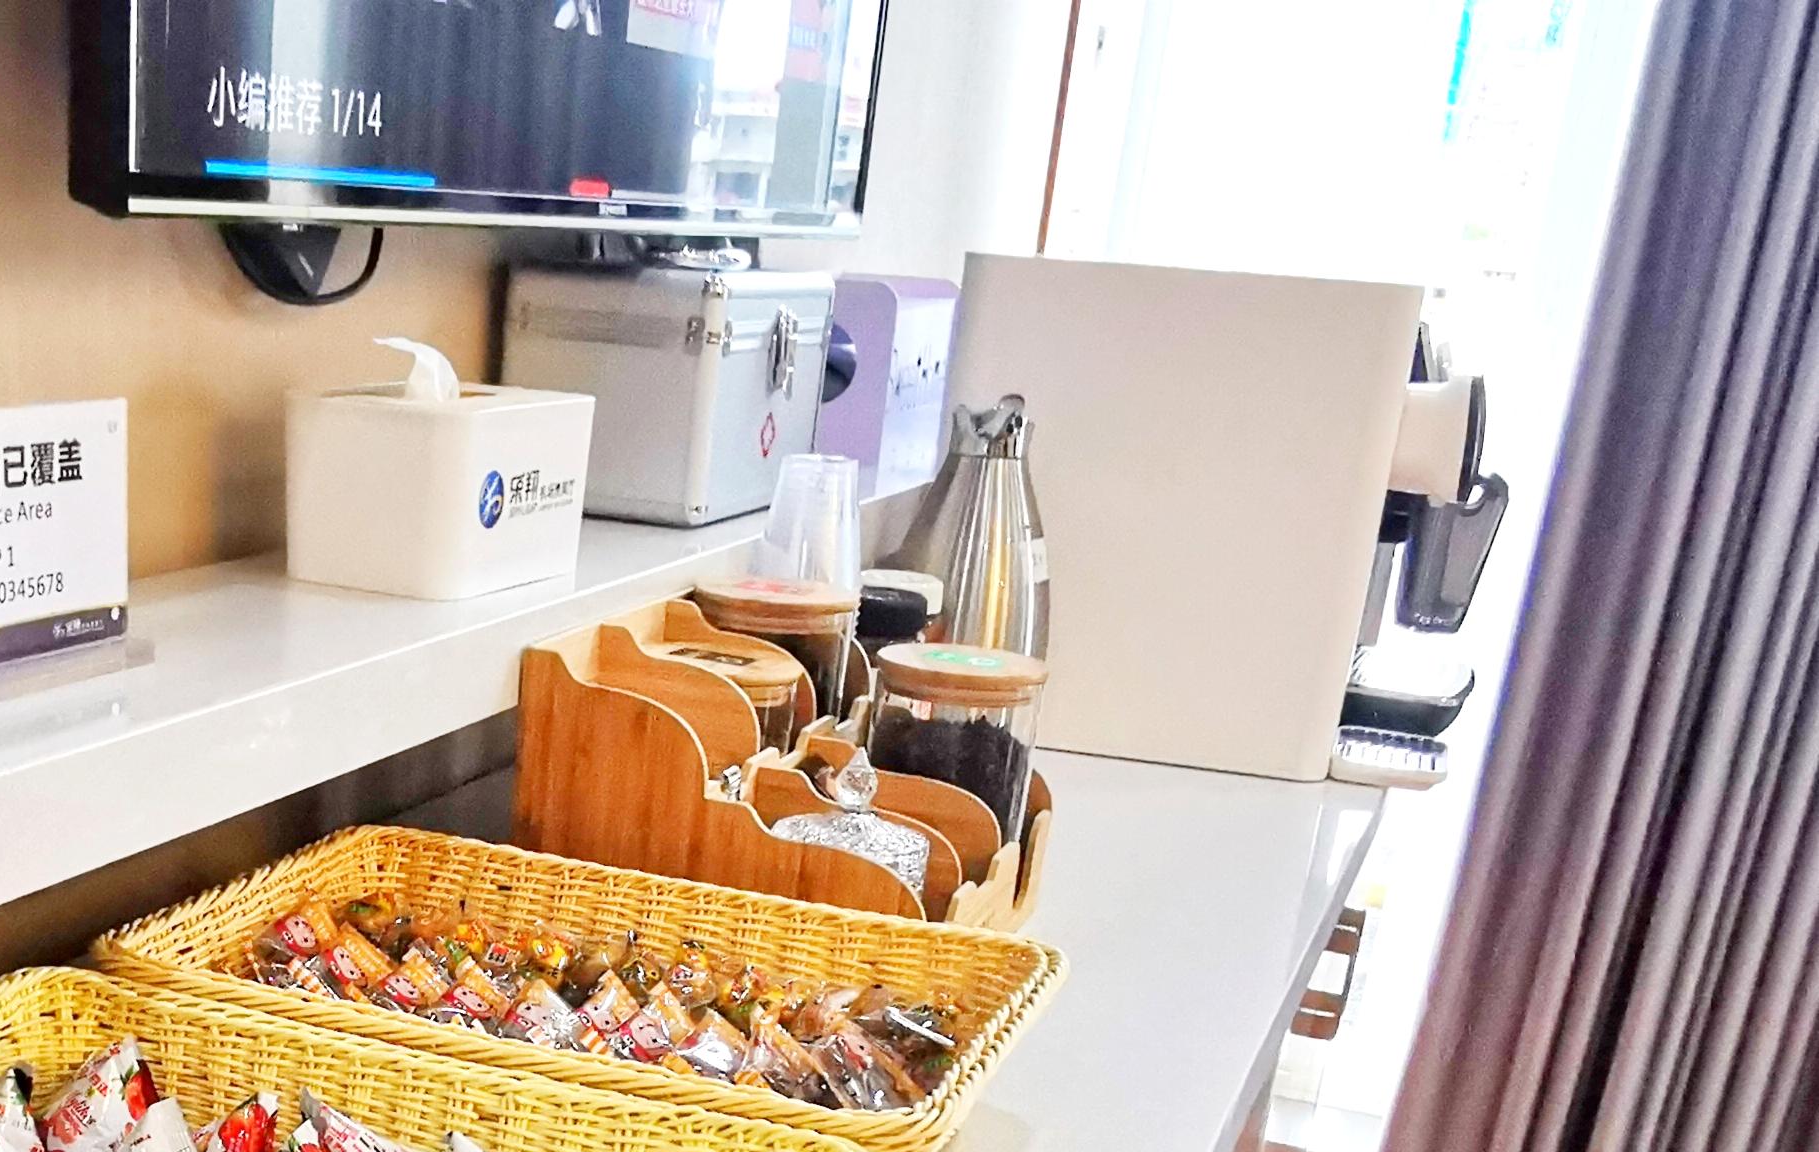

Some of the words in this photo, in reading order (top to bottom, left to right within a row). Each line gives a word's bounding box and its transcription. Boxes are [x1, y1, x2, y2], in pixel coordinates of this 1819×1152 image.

[207, 65, 324, 136] 小编推荐
[331, 88, 382, 137] 1/14
[17, 501, 53, 521] Area
[8, 546, 15, 567] 1
